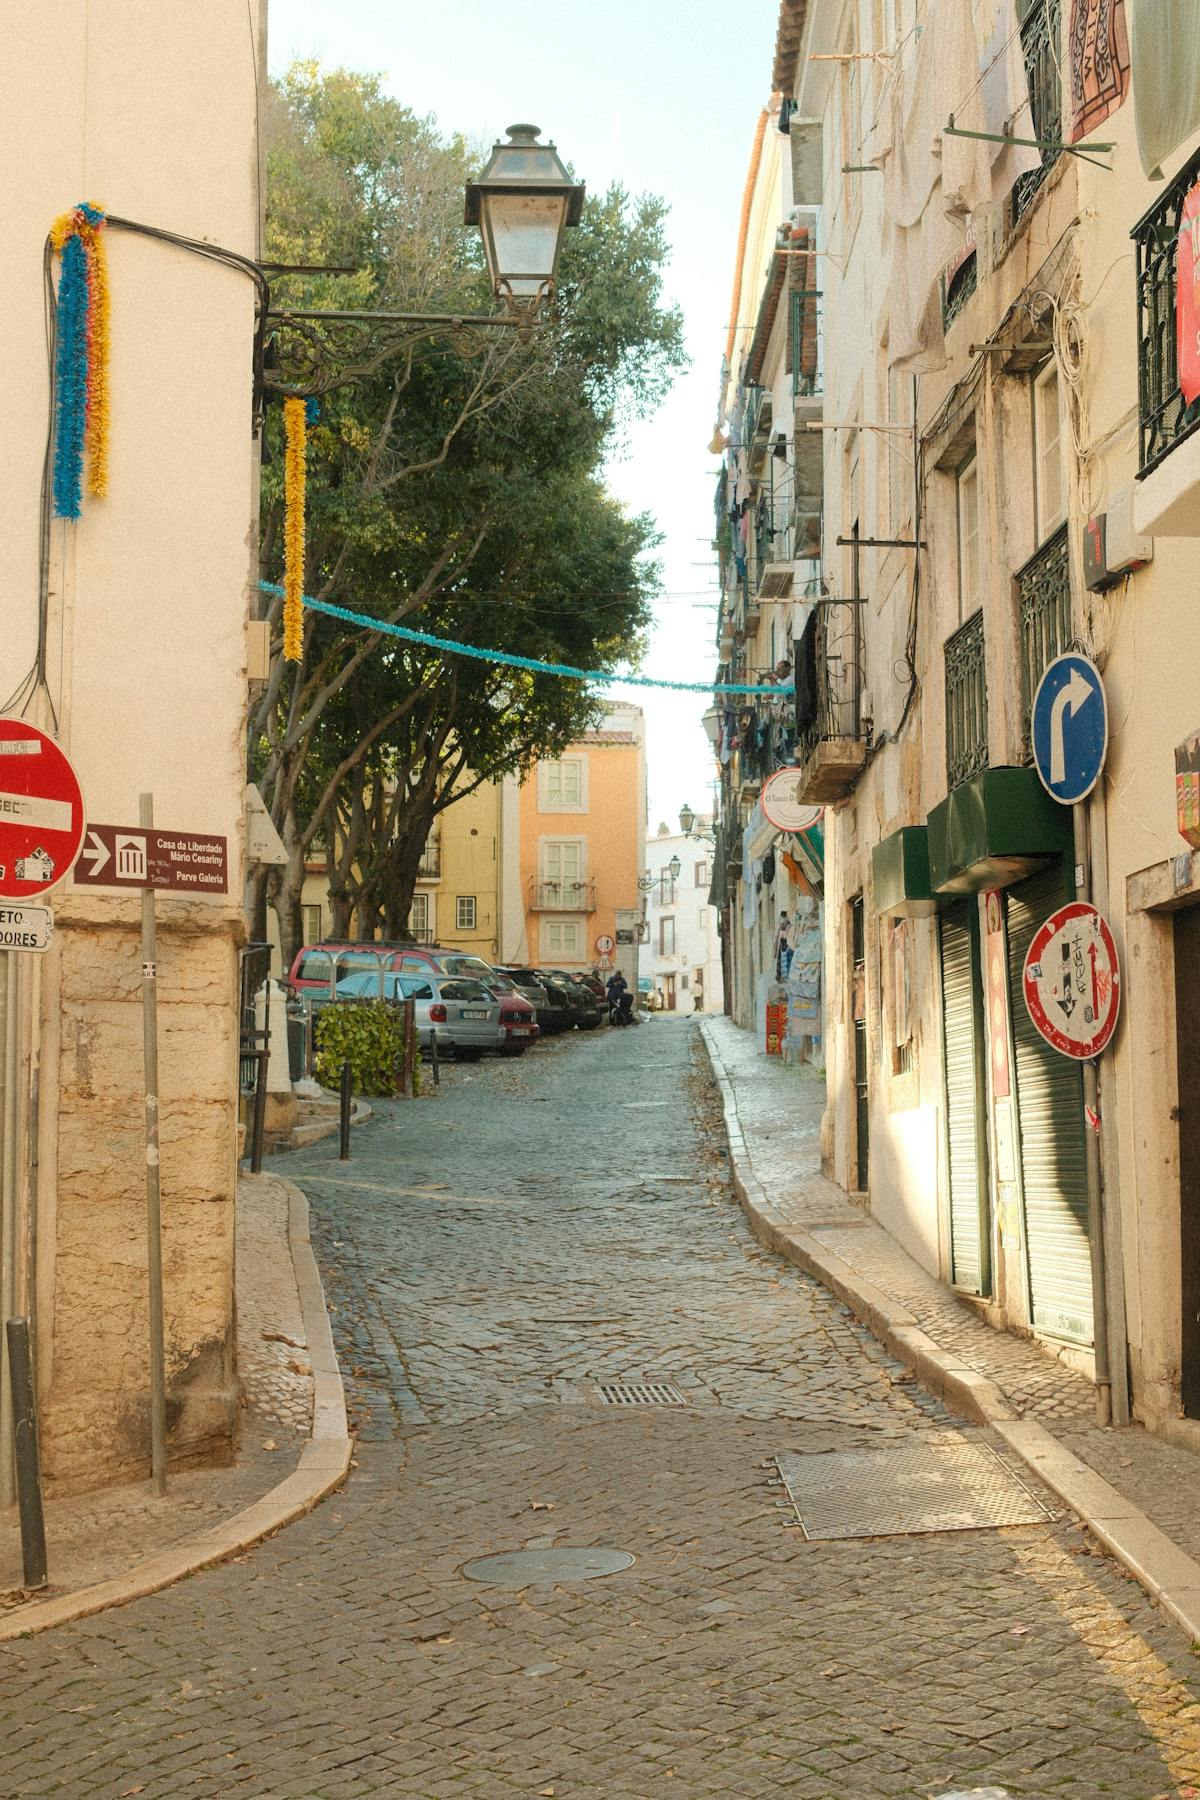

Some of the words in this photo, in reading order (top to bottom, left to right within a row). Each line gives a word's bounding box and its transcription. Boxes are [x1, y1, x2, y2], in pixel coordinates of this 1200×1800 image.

[157, 838, 176, 850] Casa
[177, 840, 187, 851] da
[188, 842, 223, 854] Liberdade
[170, 851, 191, 863] Mário
[192, 853, 223, 867] Cesariny
[176, 870, 197, 882] Perve
[198, 872, 224, 884] Galeria
